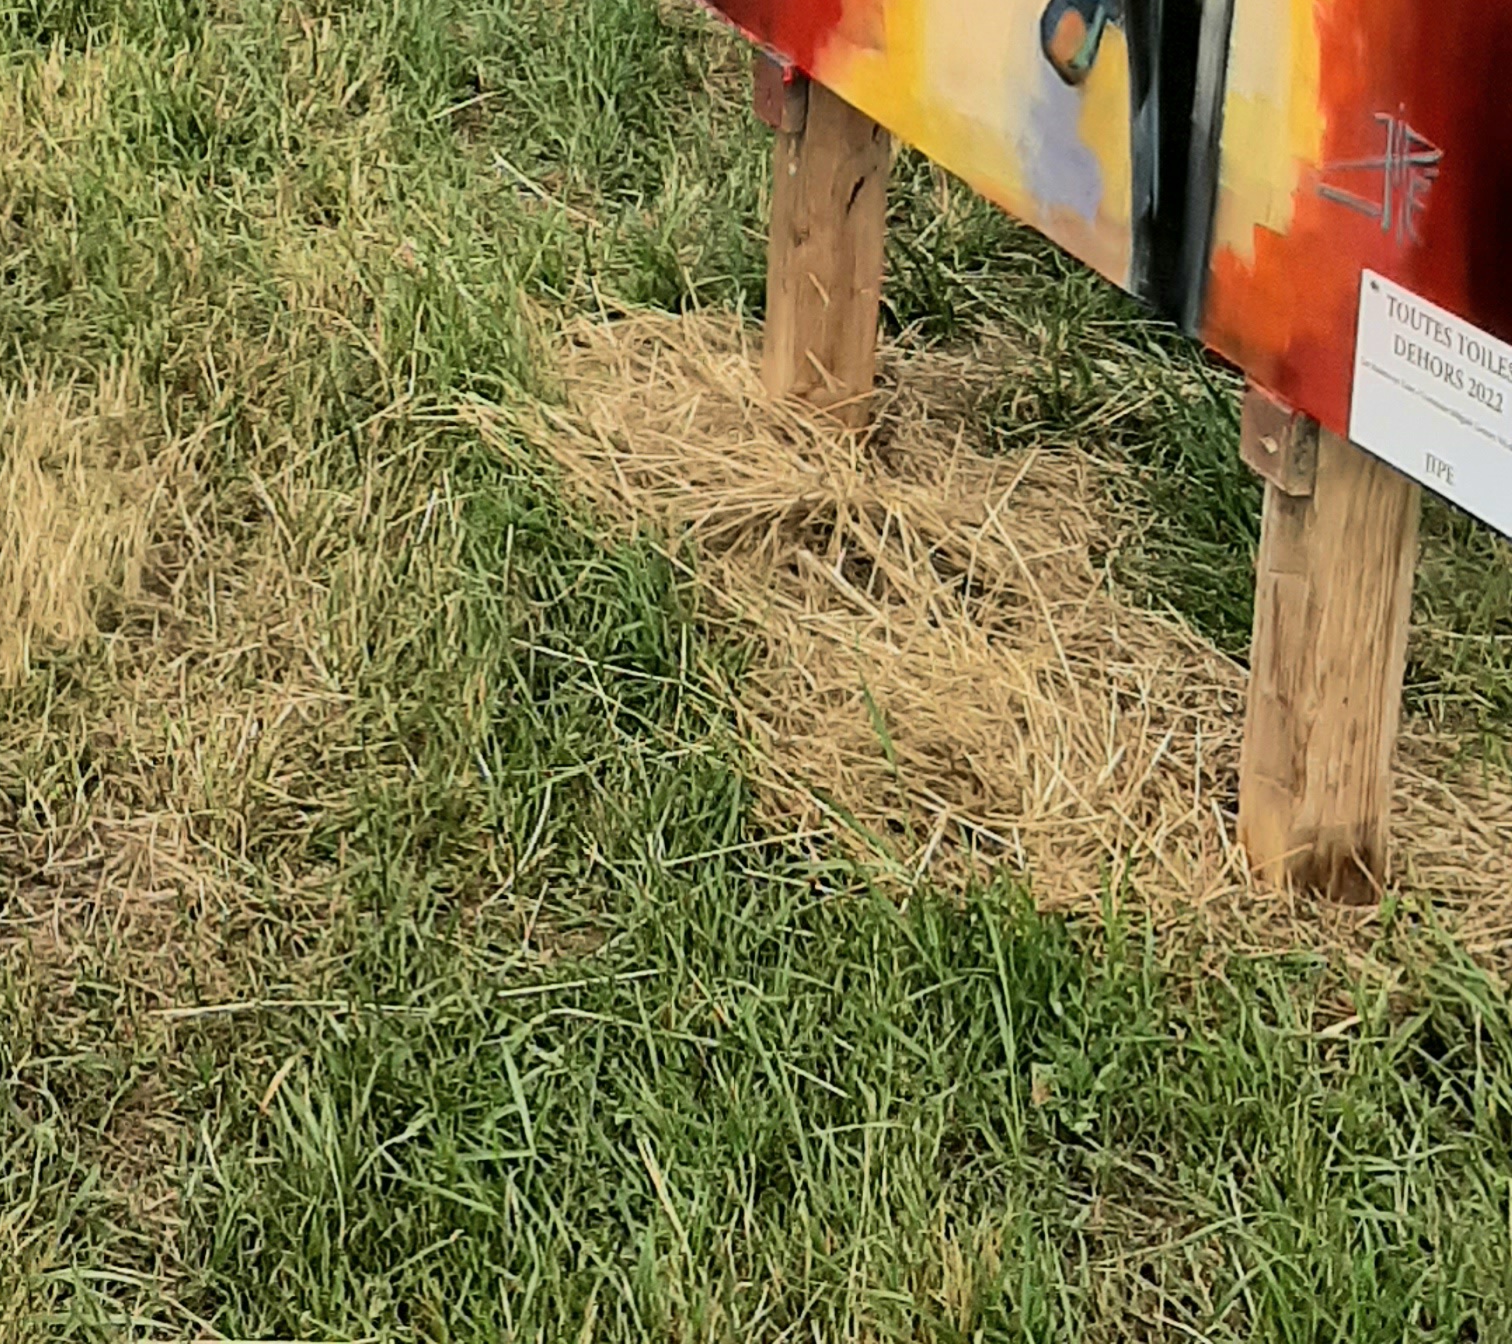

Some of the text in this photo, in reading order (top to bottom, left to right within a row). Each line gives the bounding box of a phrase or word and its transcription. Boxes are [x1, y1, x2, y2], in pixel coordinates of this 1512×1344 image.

[1386, 293, 1452, 348] TOUTES
[1393, 333, 1464, 390] DEHORS
[1467, 377, 1503, 413] 2022
